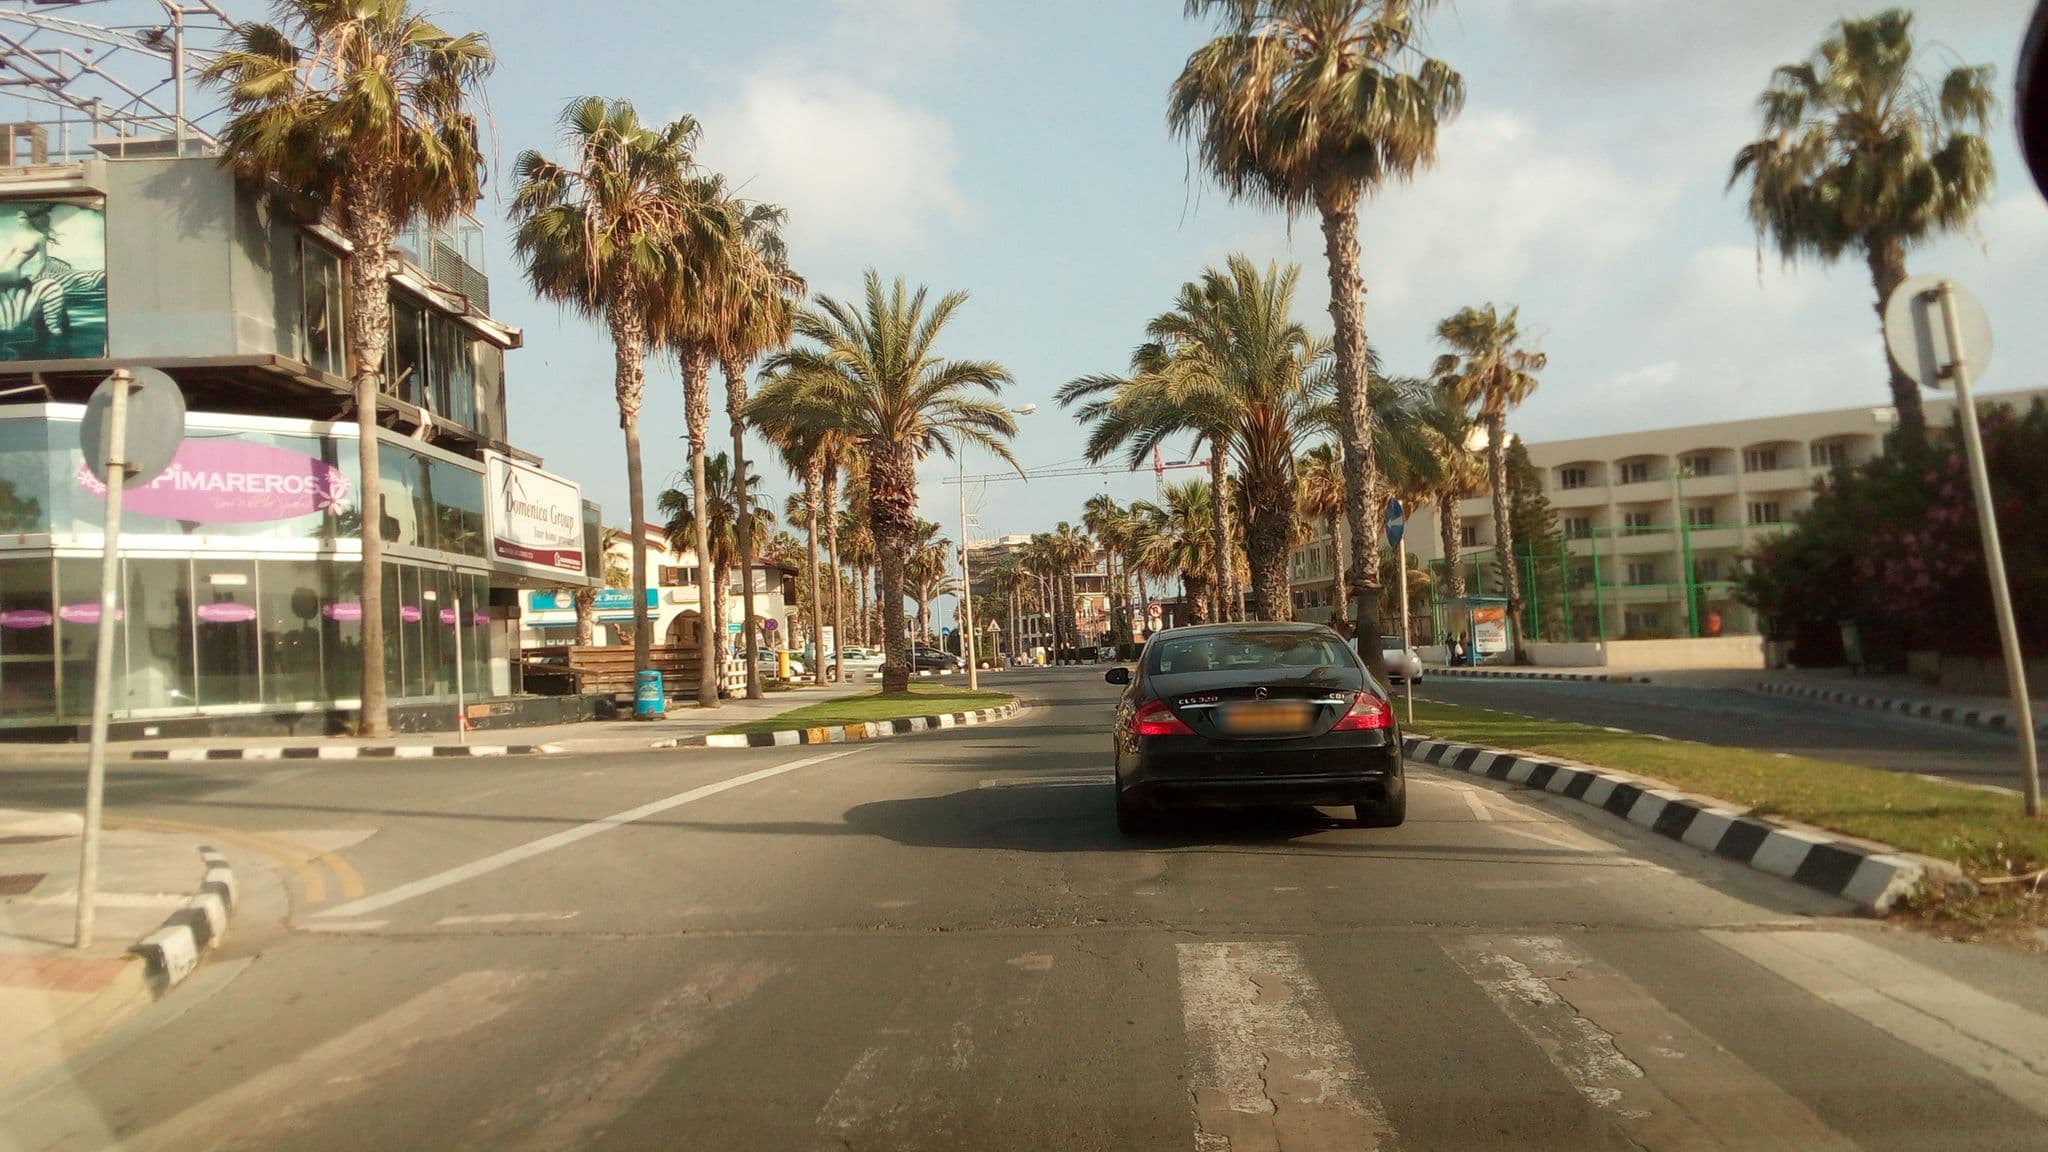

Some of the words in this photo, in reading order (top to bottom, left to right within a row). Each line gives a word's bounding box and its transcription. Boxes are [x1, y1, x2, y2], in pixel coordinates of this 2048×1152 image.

[506, 490, 548, 522] Domenica
[550, 504, 574, 536] Group
[1329, 692, 1345, 700] CDI
[1178, 697, 1197, 705] CLS
